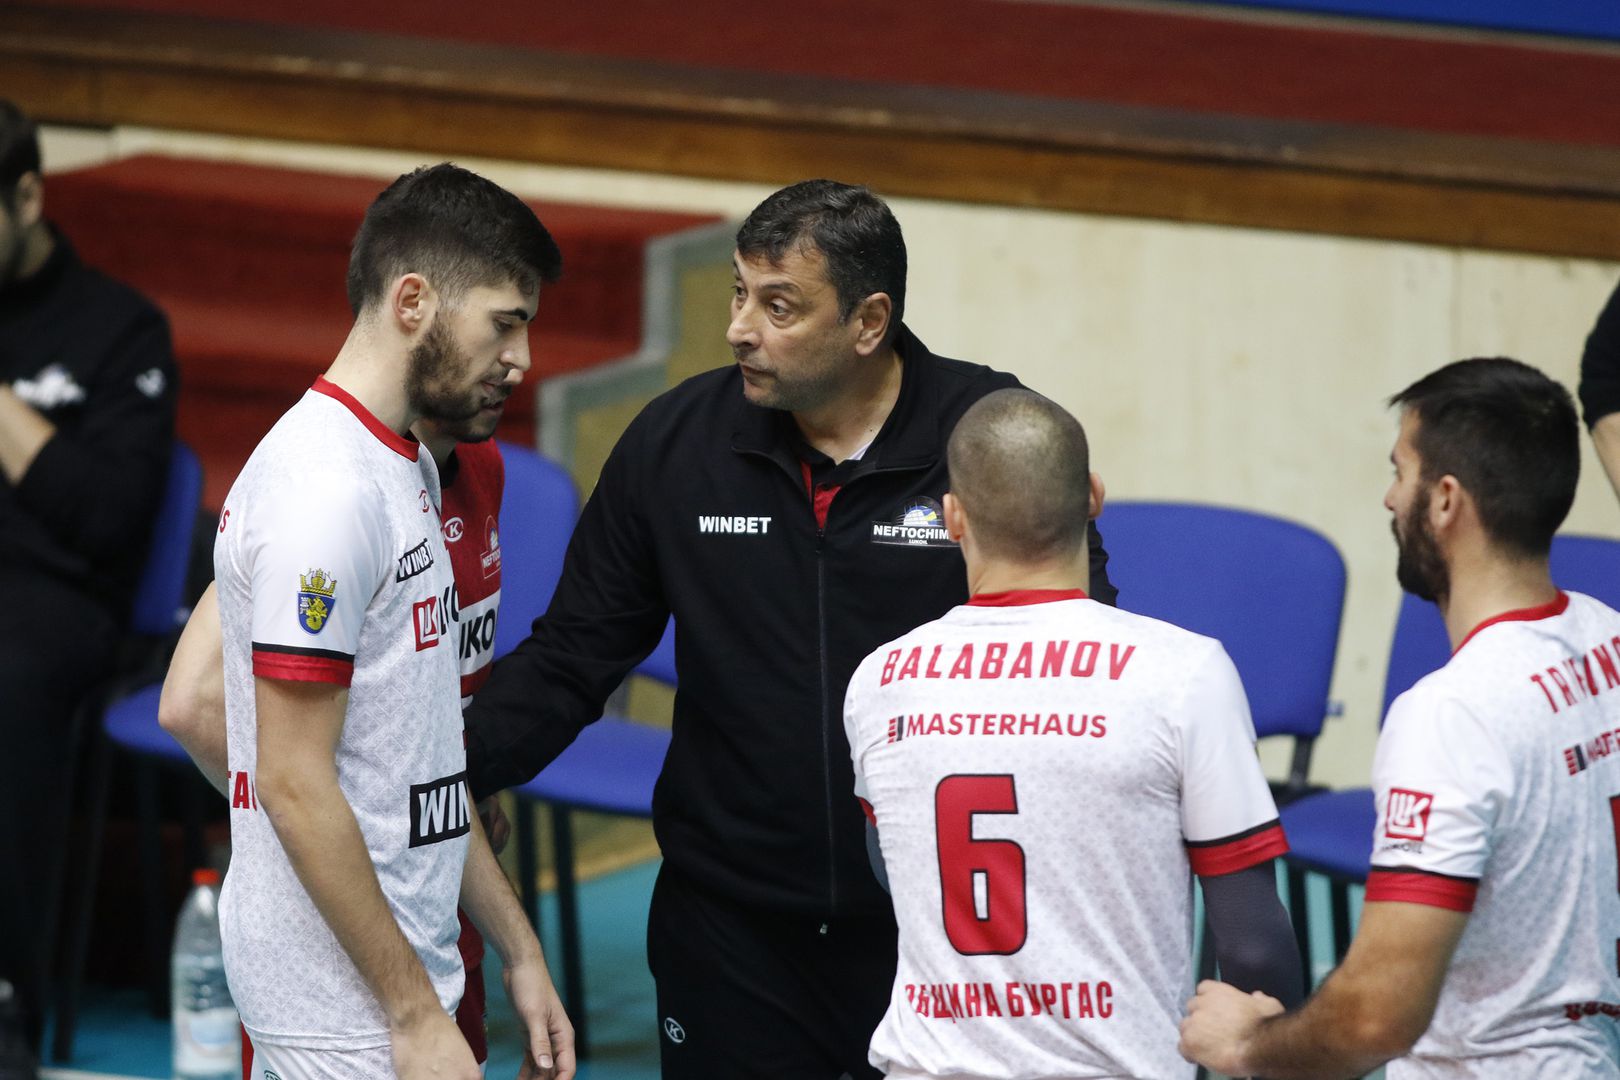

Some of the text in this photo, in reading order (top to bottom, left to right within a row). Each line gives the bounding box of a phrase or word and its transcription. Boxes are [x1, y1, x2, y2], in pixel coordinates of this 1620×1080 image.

[699, 515, 771, 534] WINBET
[880, 640, 1137, 687] BALABANOV
[906, 713, 1107, 738] MASTERHAUS
[934, 773, 1028, 957] 6
[1006, 980, 1113, 1019] БУРГАС
